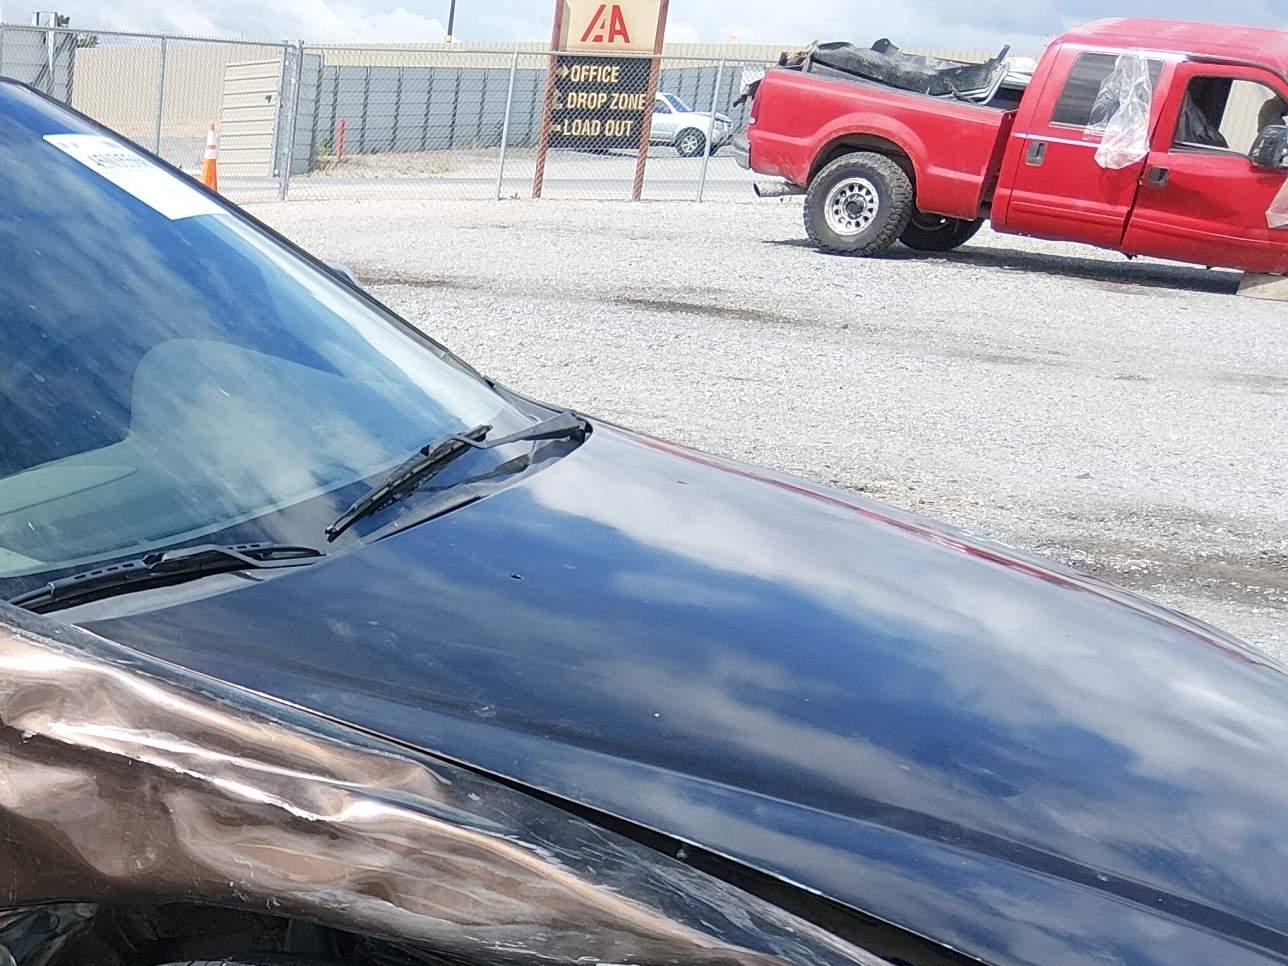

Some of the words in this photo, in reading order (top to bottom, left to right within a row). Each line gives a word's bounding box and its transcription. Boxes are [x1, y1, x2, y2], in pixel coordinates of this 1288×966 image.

[570, 65, 620, 84] OFFICE
[567, 92, 608, 110] DROP
[611, 93, 647, 111] ZONE
[562, 119, 601, 137] LOAD
[605, 120, 634, 138] OUT
